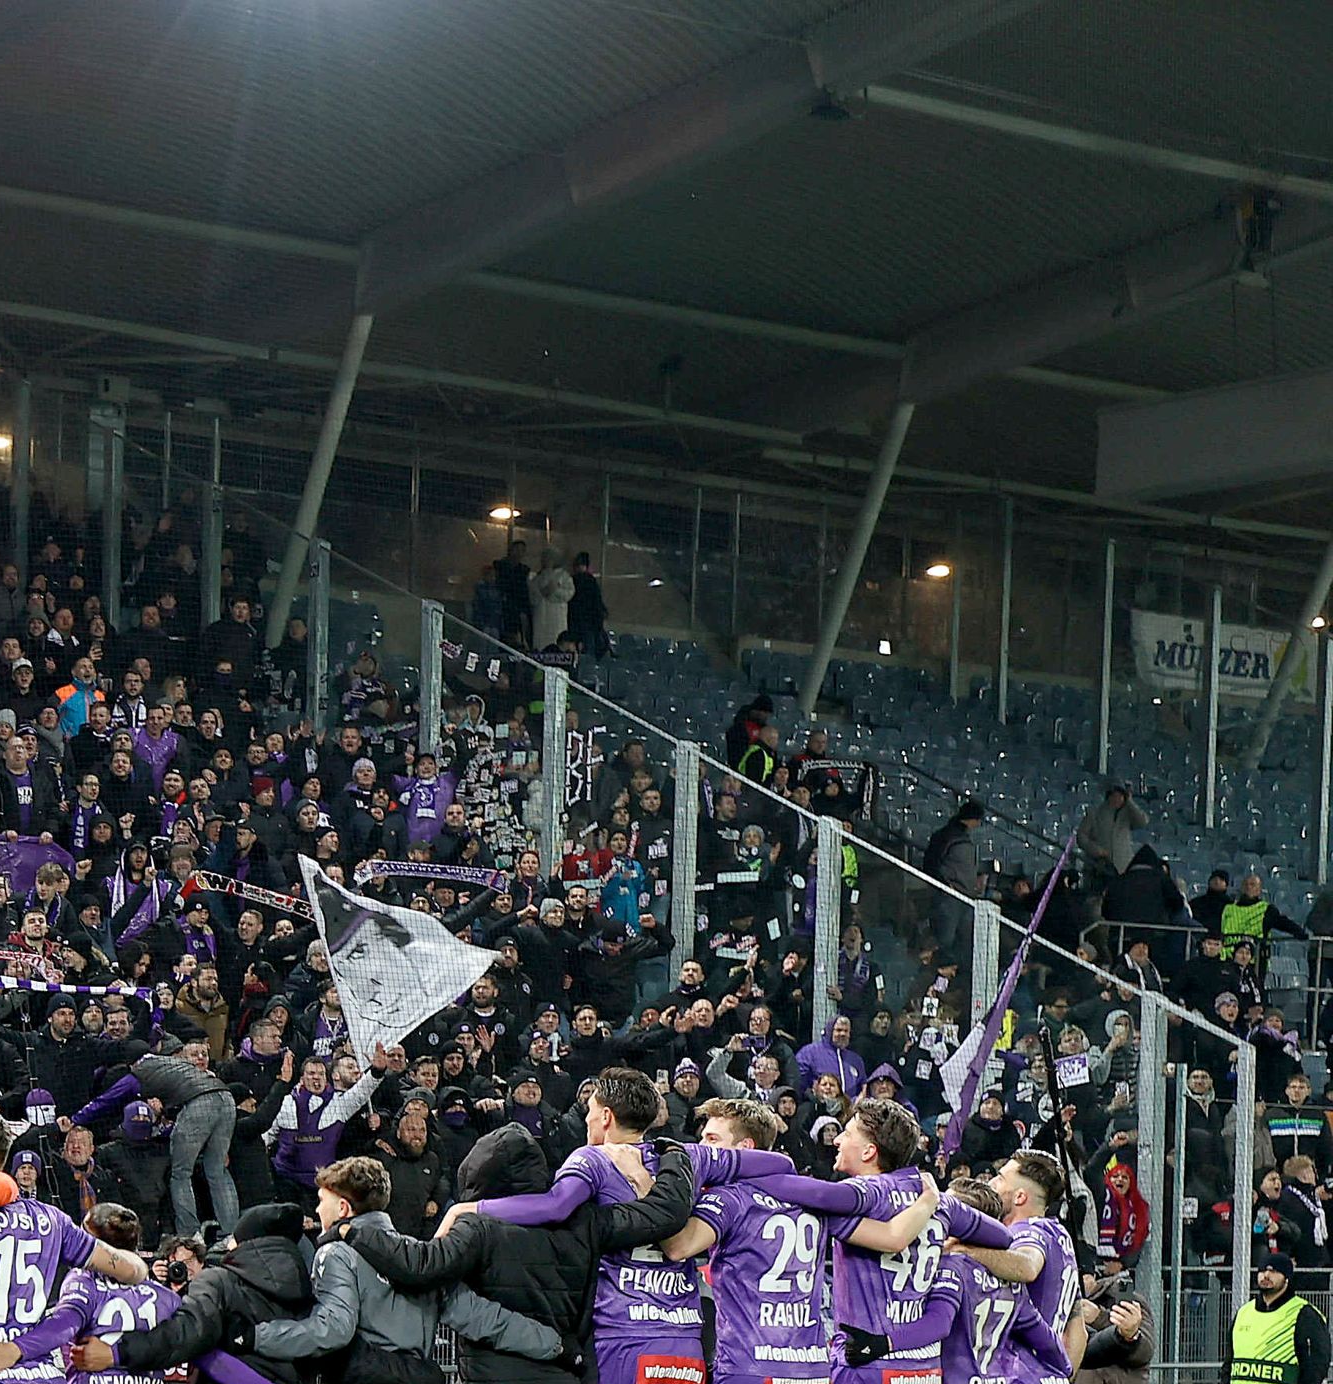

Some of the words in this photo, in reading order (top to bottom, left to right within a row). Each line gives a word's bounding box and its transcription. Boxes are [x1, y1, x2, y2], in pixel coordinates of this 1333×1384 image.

[1154, 626, 1270, 679] MÜZER
[758, 1212, 821, 1293] 29
[880, 1217, 944, 1293] 46
[974, 1298, 1016, 1375] 17
